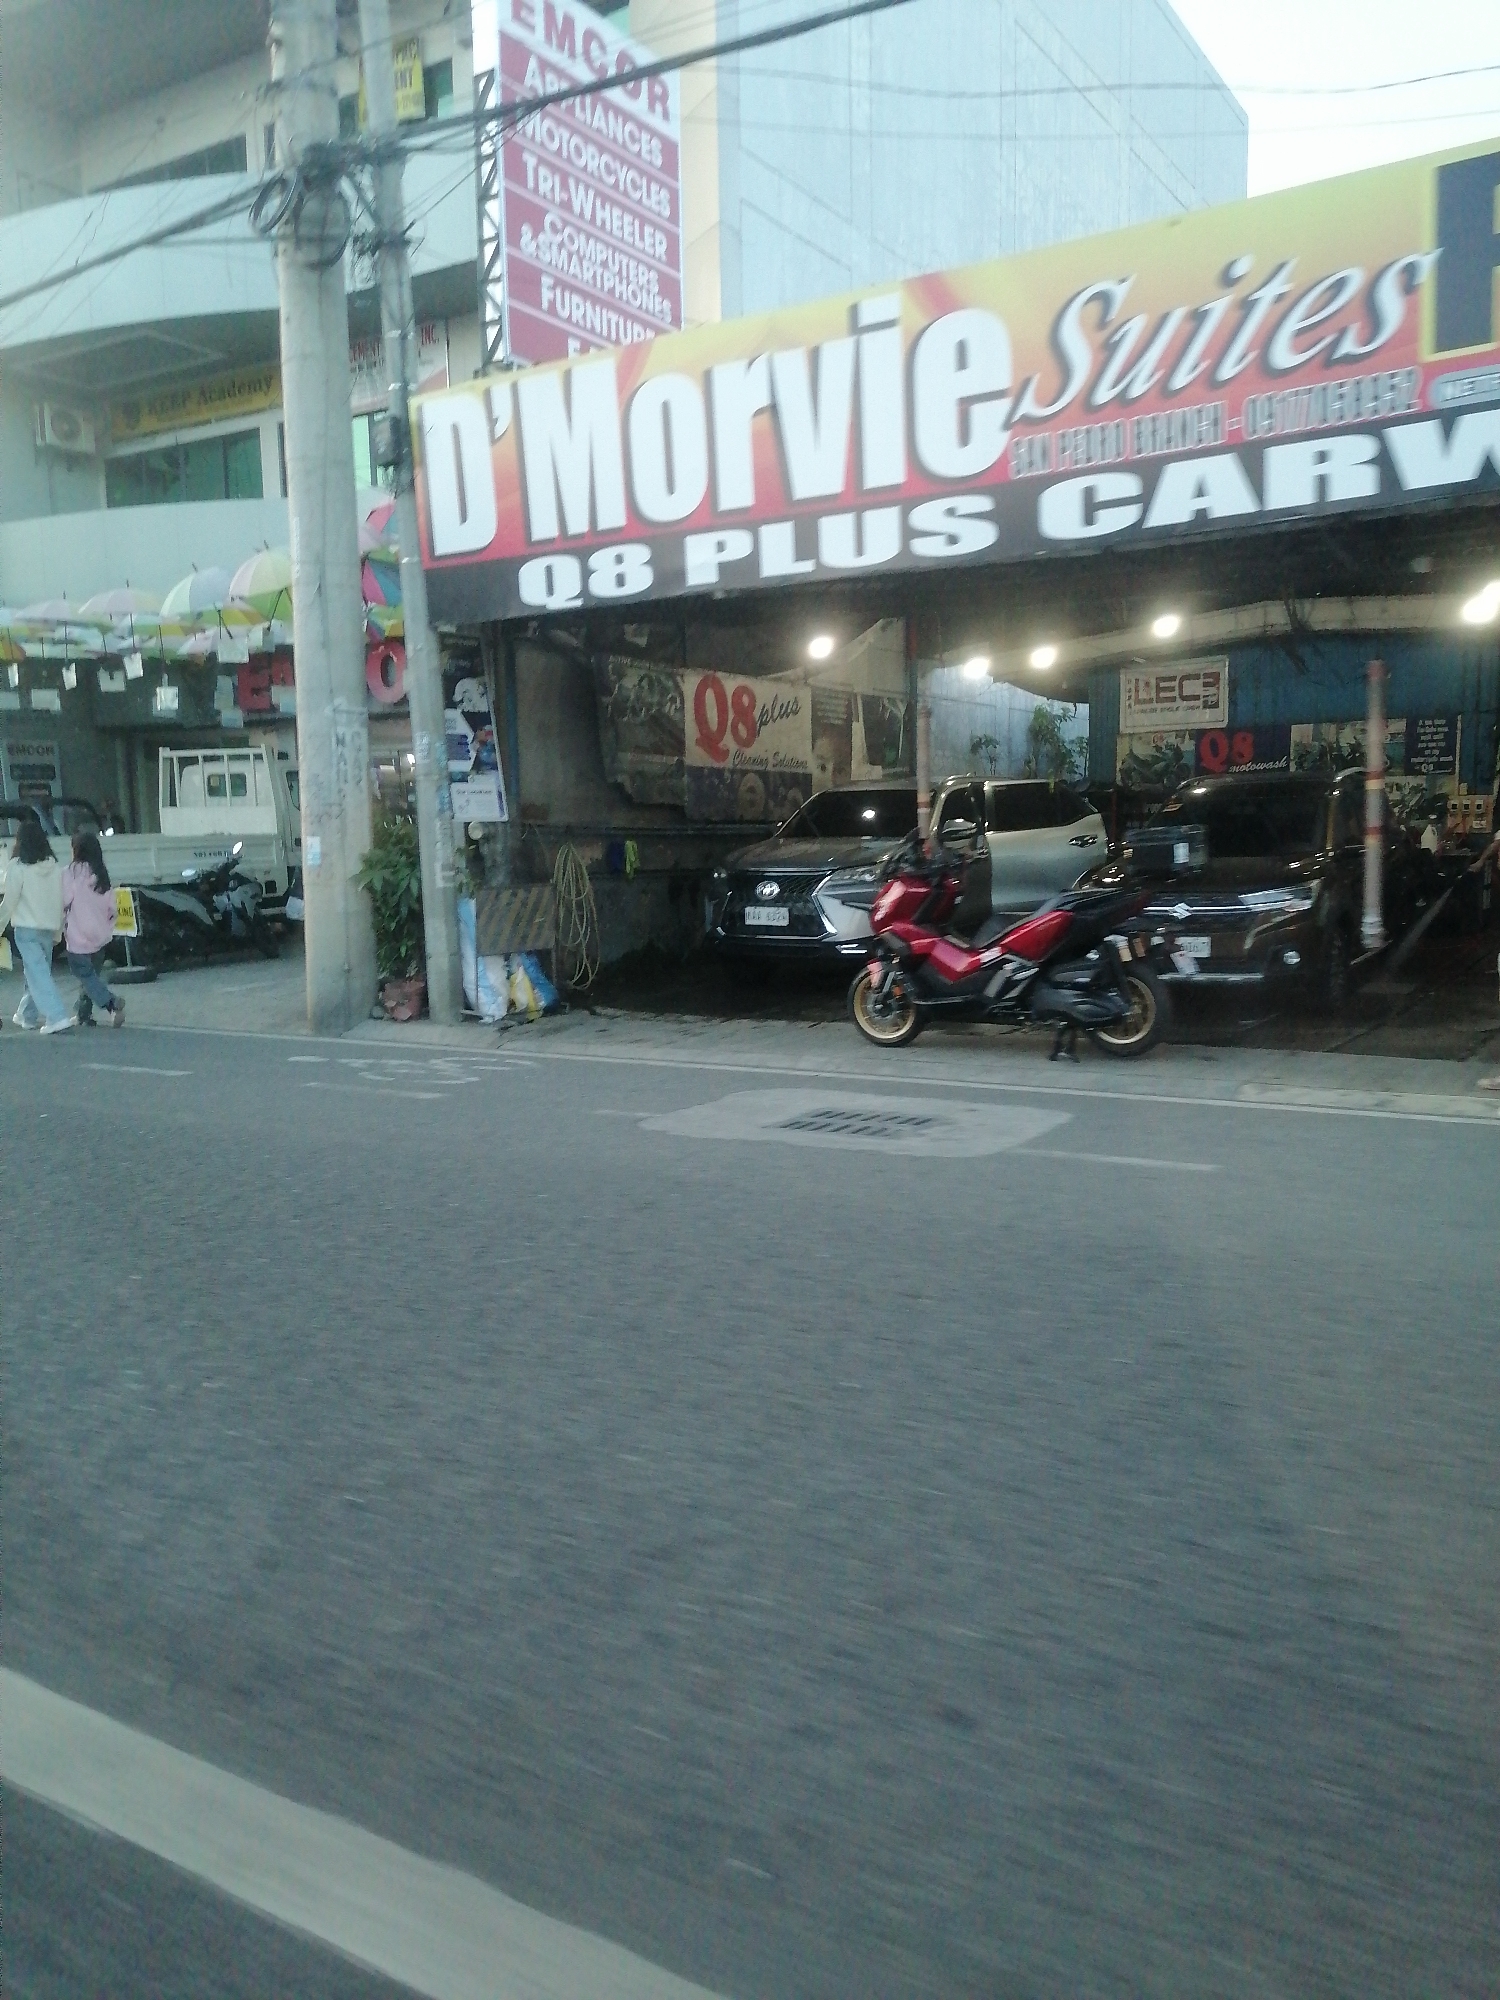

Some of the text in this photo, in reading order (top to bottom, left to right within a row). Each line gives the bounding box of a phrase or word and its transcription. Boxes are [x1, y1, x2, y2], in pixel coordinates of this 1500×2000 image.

[522, 150, 668, 262] TRI-WHEELER
[543, 211, 659, 293] COMPUTERS
[421, 291, 1014, 557] D'Morvie
[1010, 246, 1443, 423] Suites
[1008, 431, 1054, 479] SAN
[1054, 417, 1127, 473] PEDRO
[1128, 400, 1228, 459] BRANCH
[517, 542, 655, 611] Q8
[684, 493, 1000, 587] PLUS
[693, 671, 757, 764] Q8
[755, 692, 802, 737] plus
[1200, 730, 1255, 773] Q8
